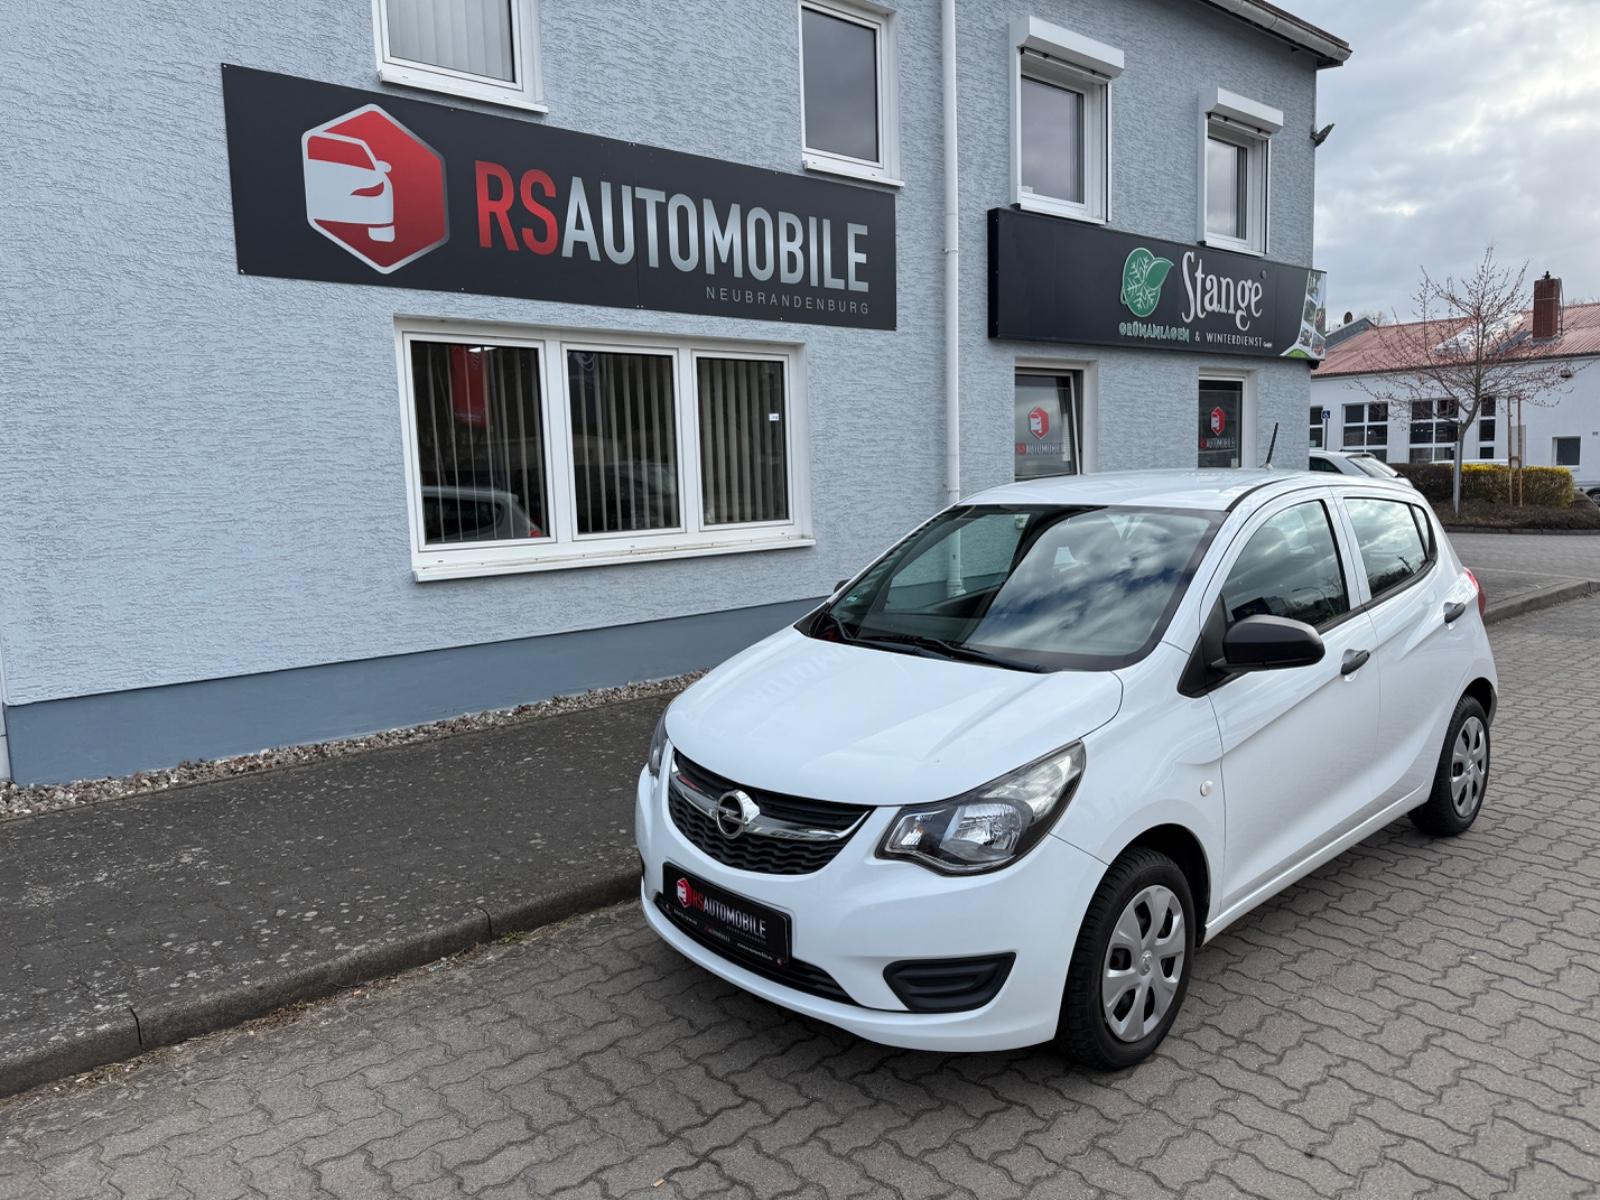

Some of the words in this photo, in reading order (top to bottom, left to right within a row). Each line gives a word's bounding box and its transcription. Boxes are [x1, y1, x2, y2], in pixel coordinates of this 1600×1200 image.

[706, 286, 869, 315] NEUBRANDENBURG
[1181, 251, 1263, 331] Stange
[1194, 331, 1201, 342] &
[1205, 331, 1263, 348] WINTERDIENST
